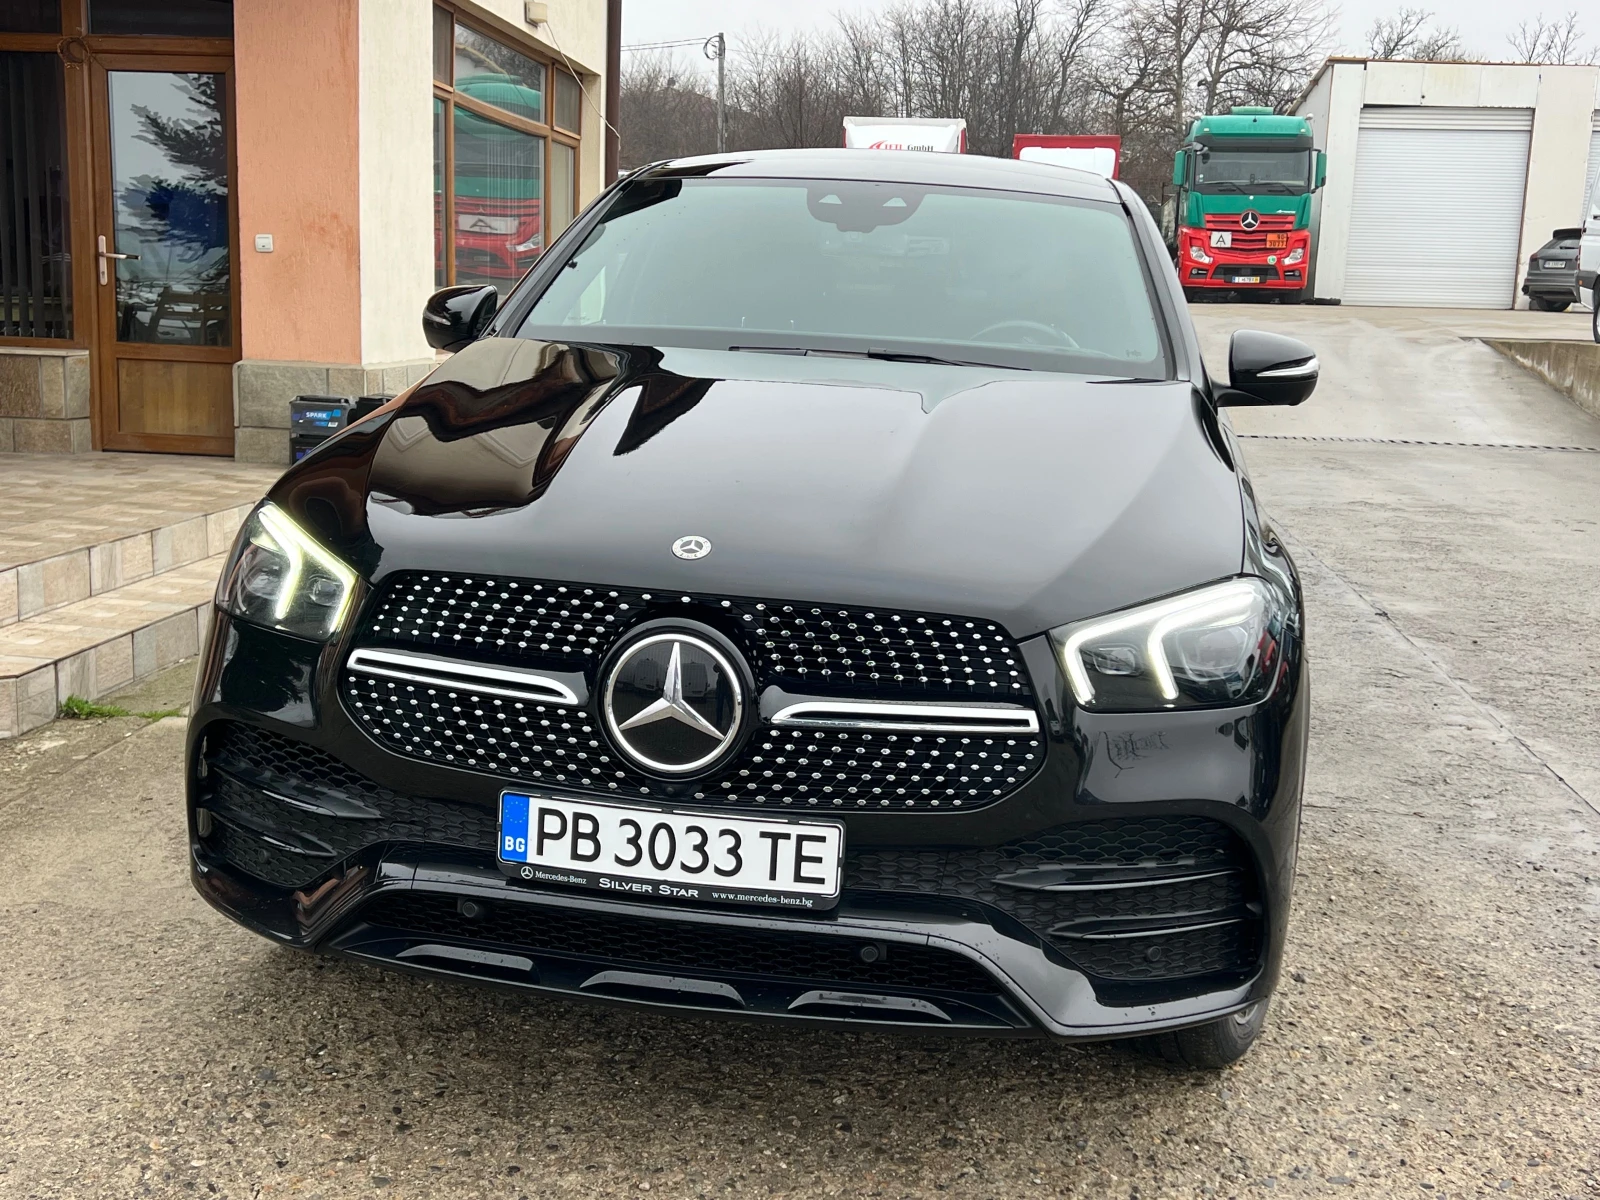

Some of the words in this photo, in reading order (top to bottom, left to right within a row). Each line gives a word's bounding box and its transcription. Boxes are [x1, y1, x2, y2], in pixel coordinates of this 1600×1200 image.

[1215, 234, 1226, 245] A
[504, 836, 526, 853] BG
[536, 807, 601, 863] PB
[614, 818, 743, 877] 3033
[759, 831, 827, 885] TE
[535, 870, 587, 885] Mercedes-Benz
[711, 891, 814, 908] www.mercedes-benz.bg
